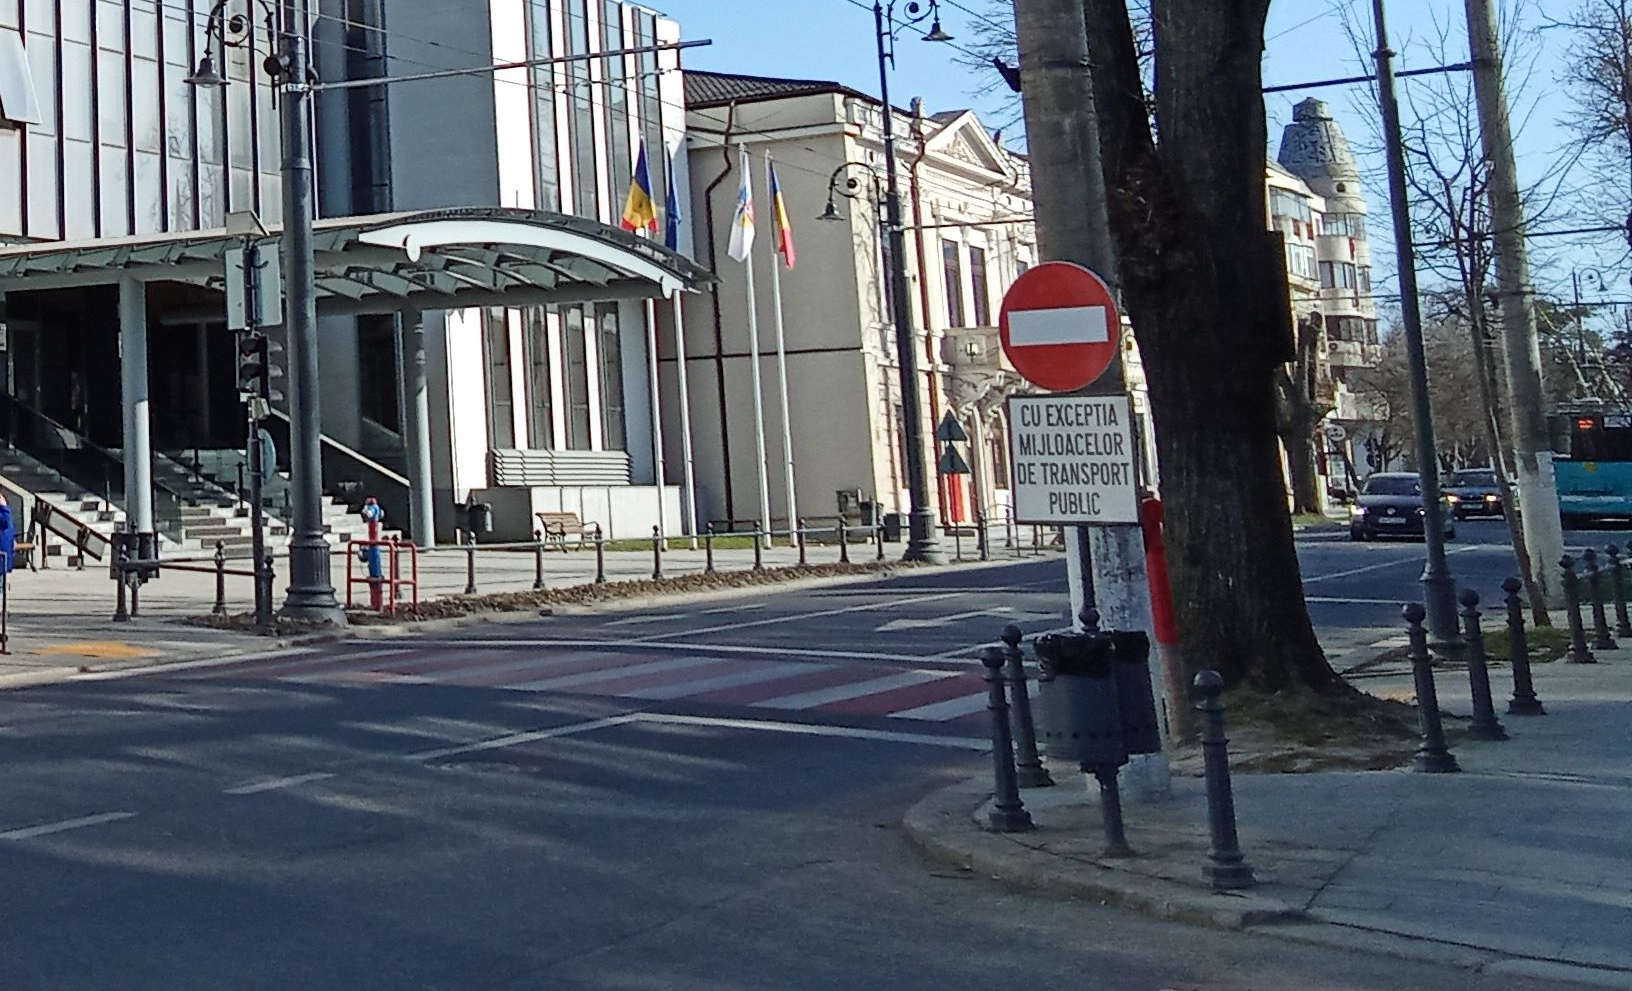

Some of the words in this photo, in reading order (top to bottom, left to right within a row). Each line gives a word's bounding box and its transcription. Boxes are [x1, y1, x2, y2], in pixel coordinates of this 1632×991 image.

[1021, 404, 1040, 426] CU
[1047, 403, 1118, 426] EXCEPTIA
[1019, 432, 1124, 456] MIJLOACELOR
[1018, 463, 1037, 485] DE
[1040, 462, 1129, 485] TRANSPORT
[1050, 492, 1101, 514] PUBLIC
